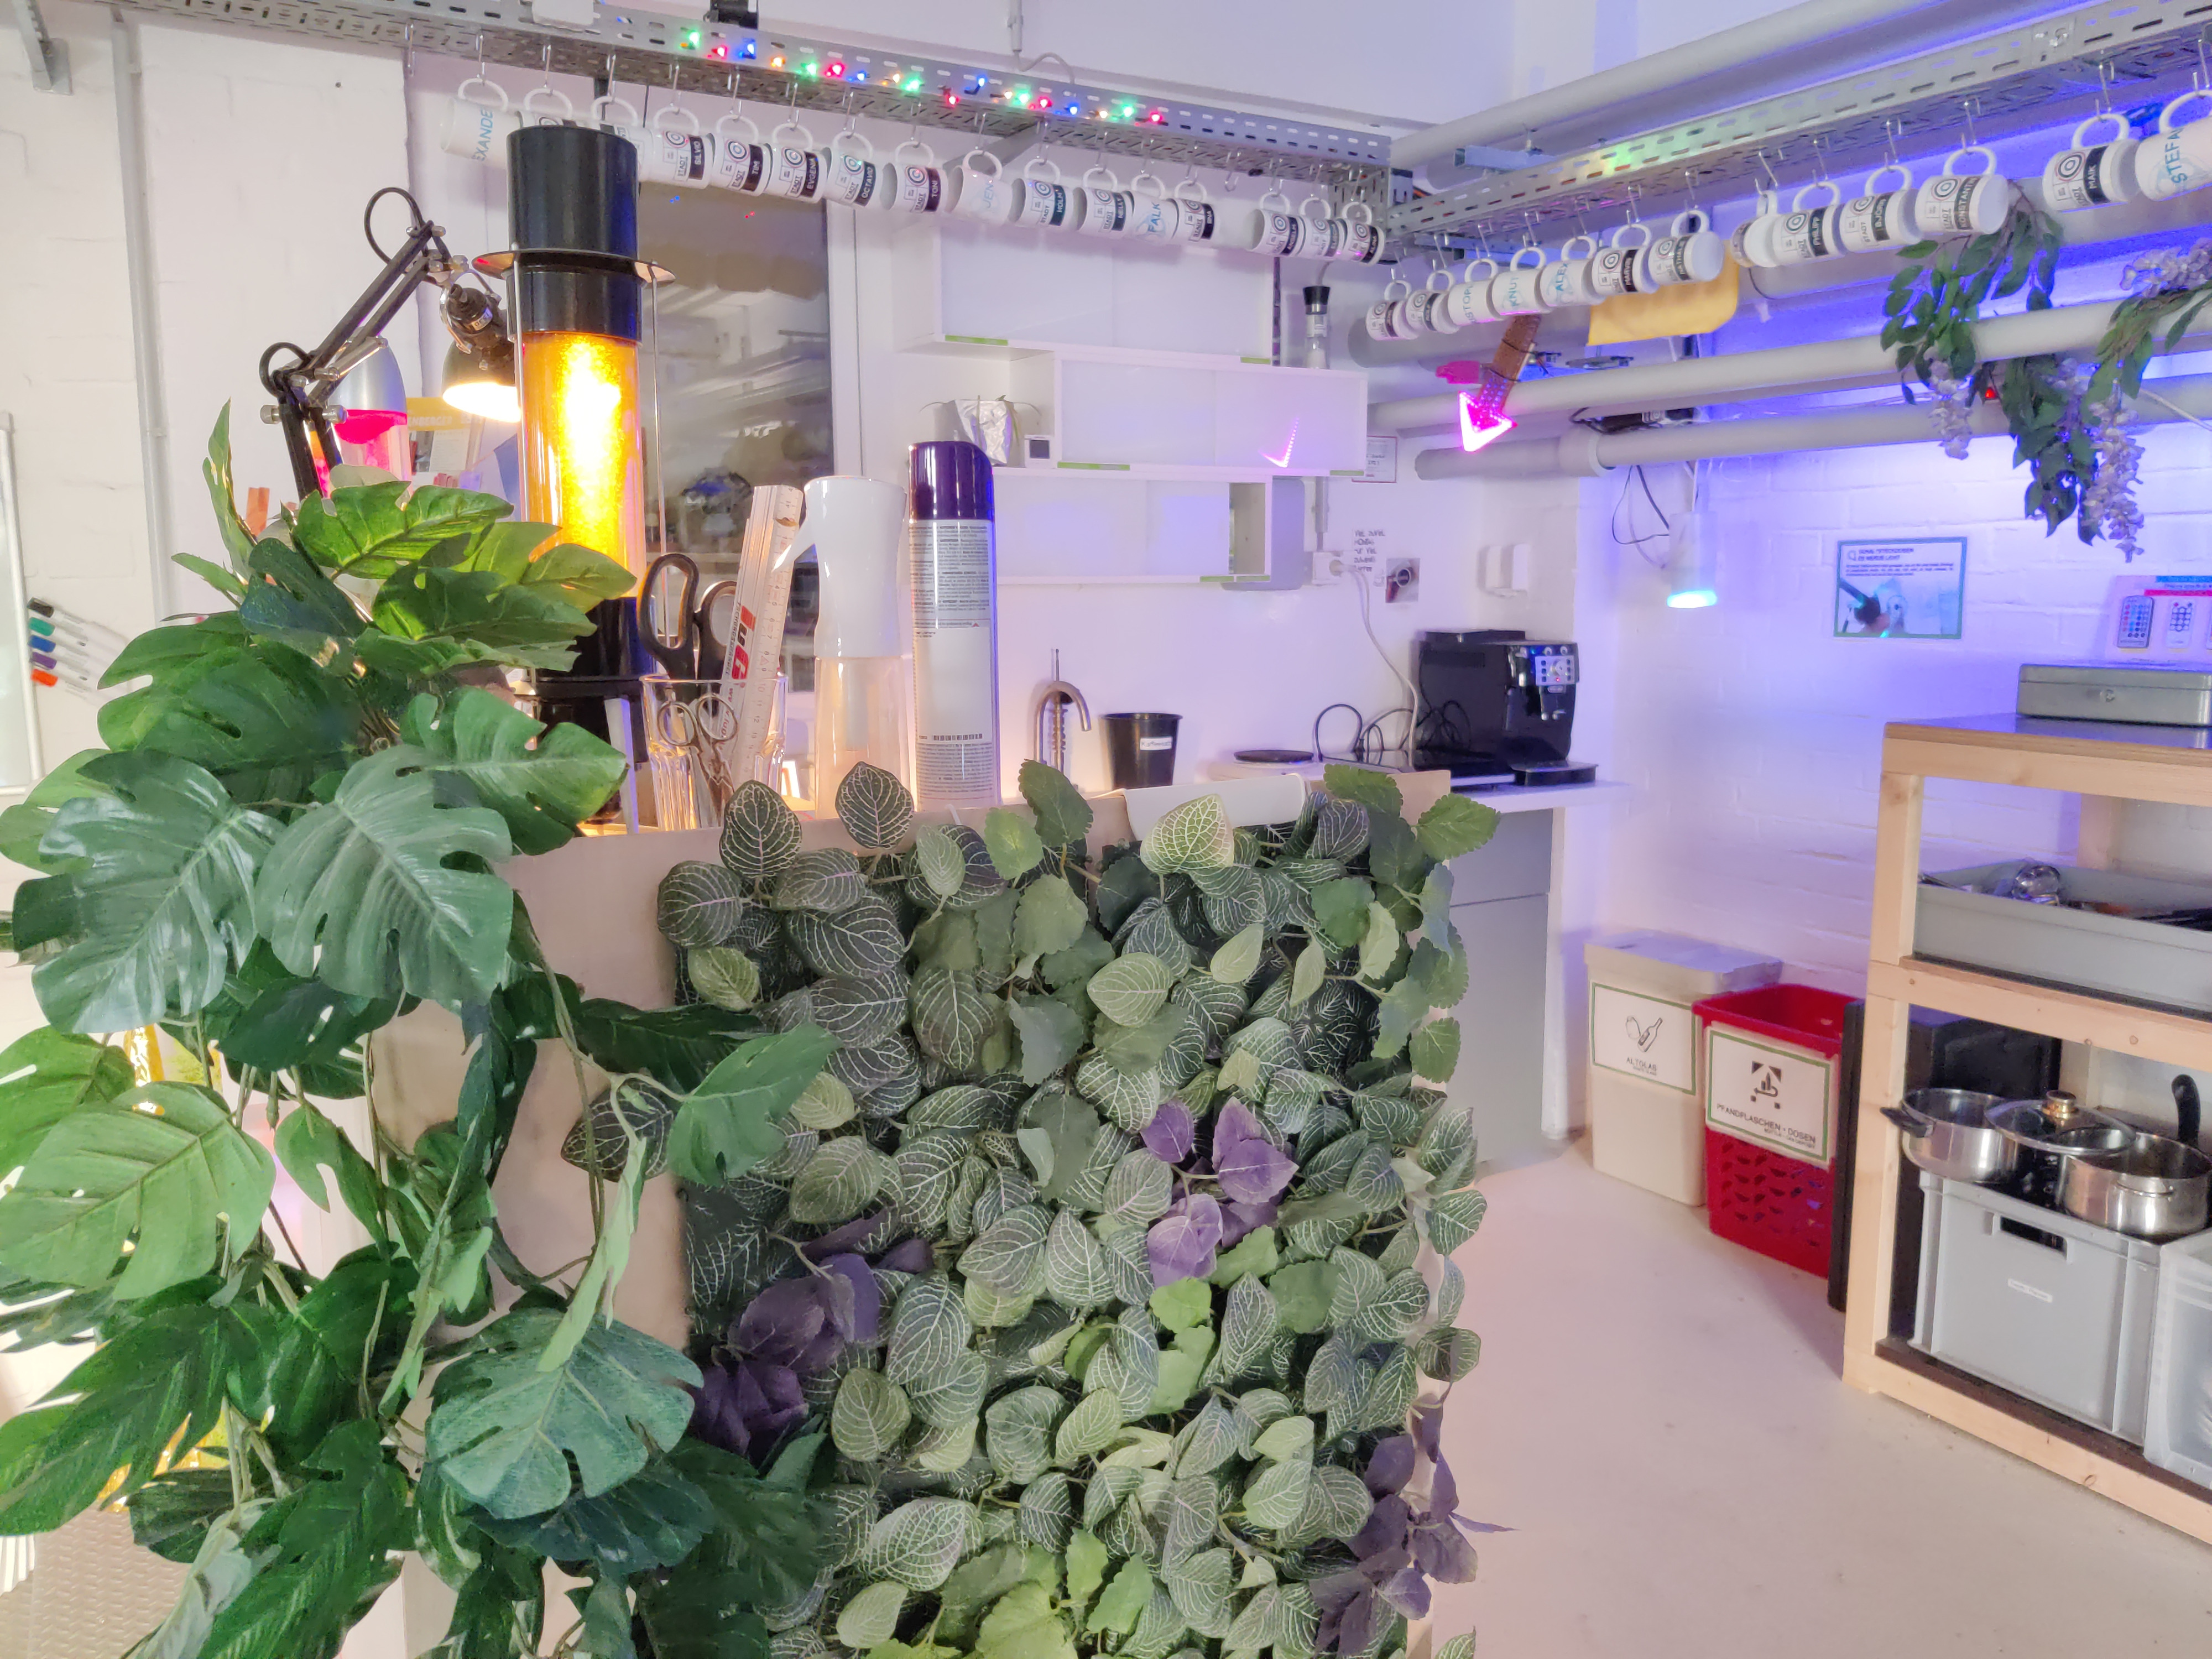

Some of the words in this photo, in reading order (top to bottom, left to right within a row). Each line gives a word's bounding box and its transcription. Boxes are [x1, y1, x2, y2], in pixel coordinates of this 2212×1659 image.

[752, 160, 760, 175] TIM
[861, 166, 873, 199] OCTAVIO
[2088, 165, 2099, 190] MAIK
[1147, 201, 1161, 233] FALK
[1716, 1103, 1781, 1131] PFANDFLASCHEN
[1787, 1127, 1816, 1144] DOSEN
